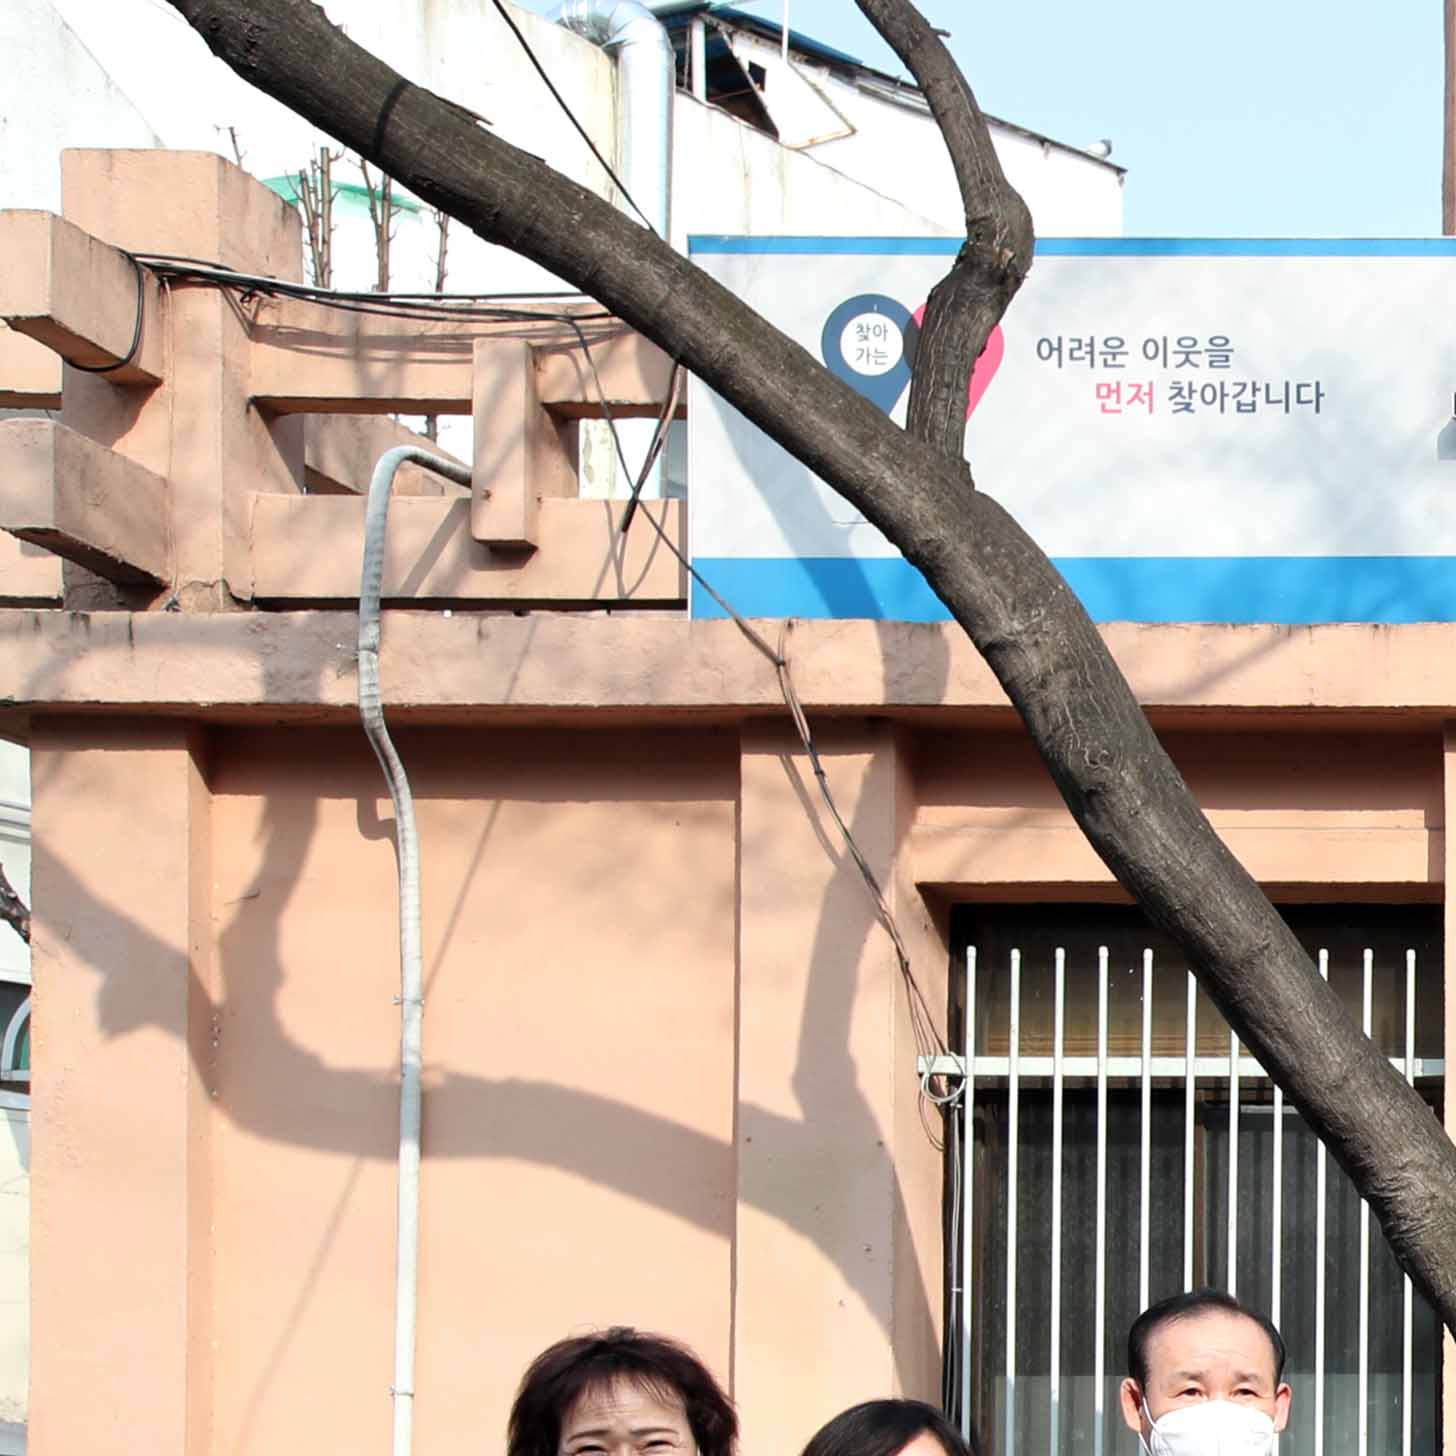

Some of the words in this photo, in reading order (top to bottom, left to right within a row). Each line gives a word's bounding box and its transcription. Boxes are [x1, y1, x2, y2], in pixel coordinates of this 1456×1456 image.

[855, 323, 889, 343] 찾아
[855, 346, 889, 366] 가는
[1035, 335, 1130, 369] 어려운
[1141, 335, 1236, 369] 이웃을
[1095, 380, 1155, 415] 먼저
[1167, 380, 1327, 415] 찾아갑니다
